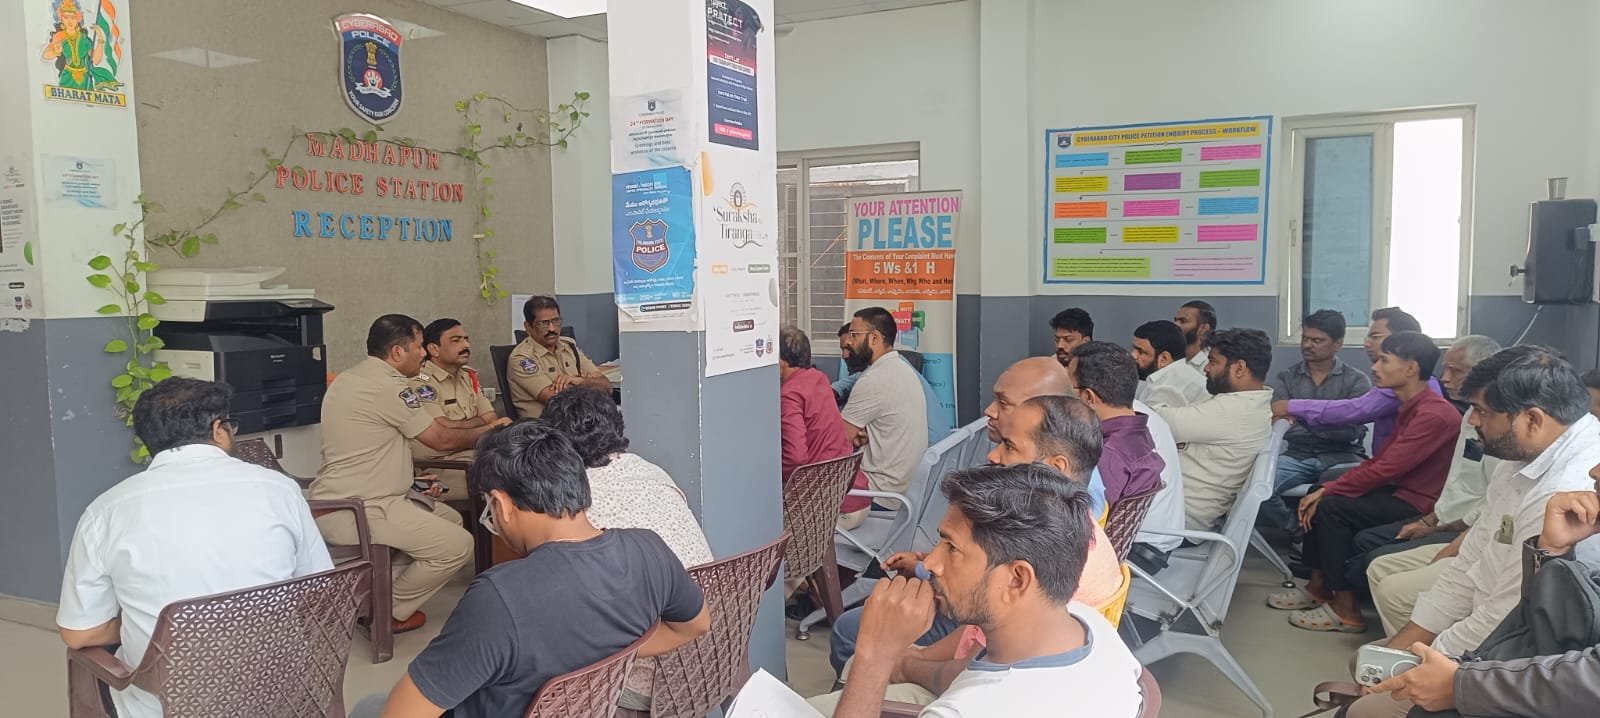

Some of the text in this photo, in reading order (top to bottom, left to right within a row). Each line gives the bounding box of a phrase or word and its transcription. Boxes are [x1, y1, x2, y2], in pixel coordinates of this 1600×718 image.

[342, 19, 398, 41] CYBERABAD
[351, 30, 392, 48] POLICE
[50, 87, 121, 104] BHARAT MATA
[306, 131, 441, 170] MADHAPUR
[275, 165, 465, 203] POLICE STATION
[713, 207, 758, 224] Suraksha
[854, 197, 959, 217] YOUR ATTENTION
[292, 209, 453, 242] RECEPTION
[720, 223, 753, 245] Tiranga
[858, 215, 953, 250] PLEASE
[636, 243, 666, 254] POLICE
[904, 252, 930, 261] Complaint
[874, 261, 881, 274] 5
[883, 261, 901, 274] Ws
[926, 261, 935, 274] H
[932, 277, 943, 285] and
